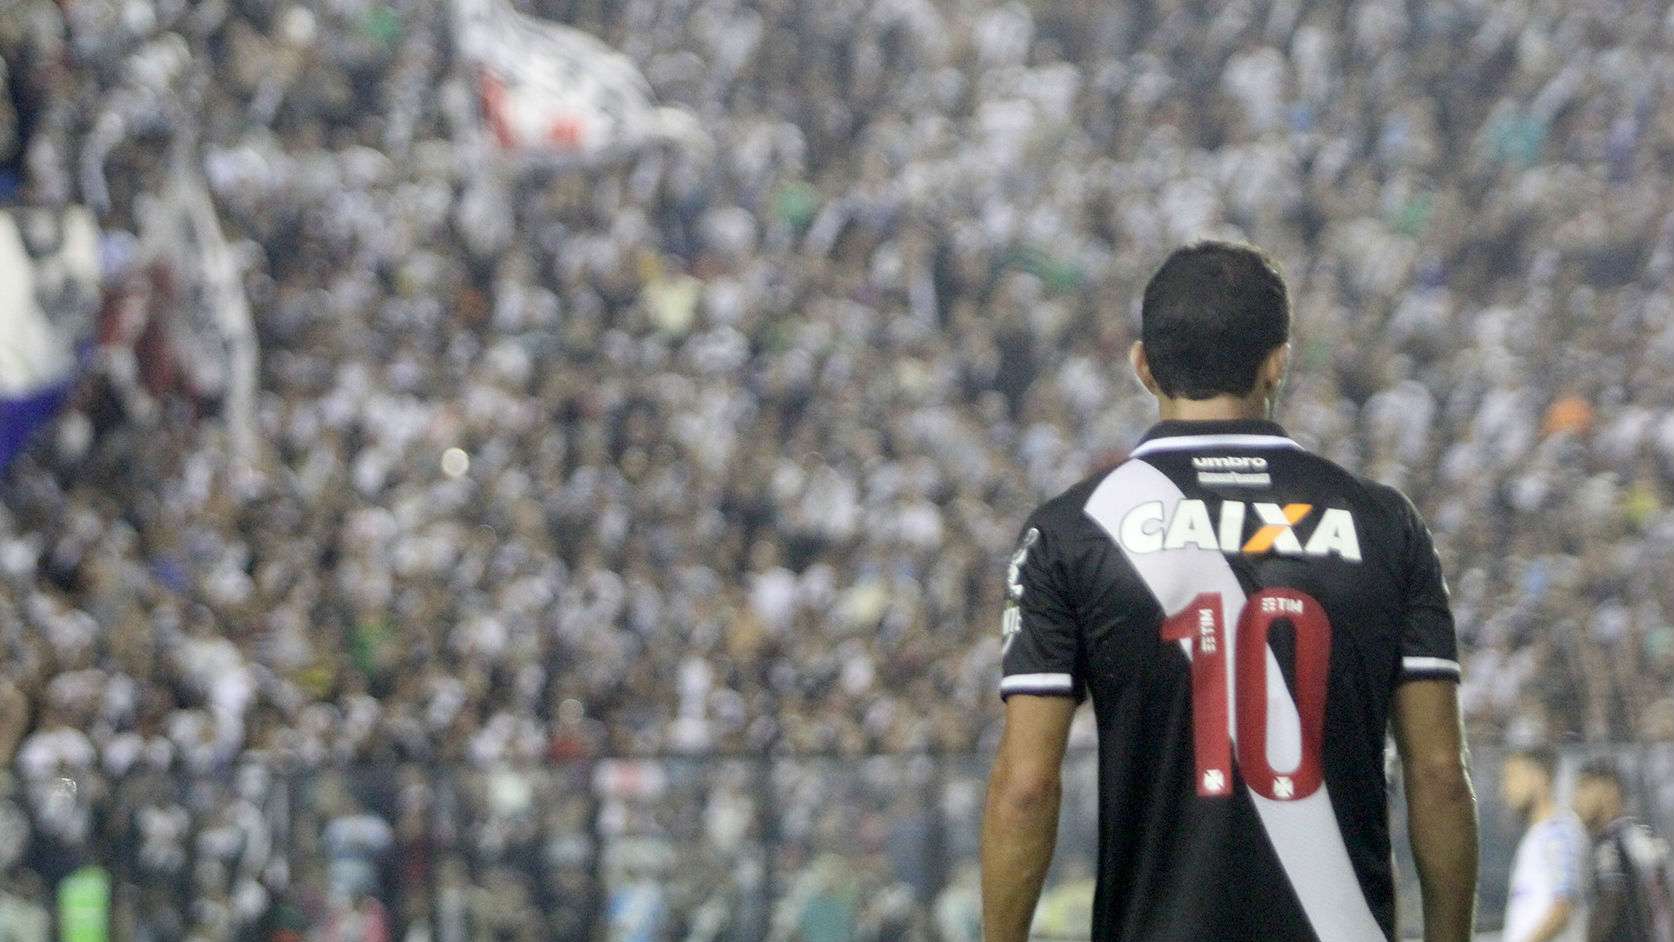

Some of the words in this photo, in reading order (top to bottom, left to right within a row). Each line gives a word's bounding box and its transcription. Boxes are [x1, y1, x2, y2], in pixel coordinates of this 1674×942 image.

[1192, 456, 1268, 470] umbro
[1120, 498, 1362, 563] CAIXA
[1277, 597, 1303, 615] TIM
[1161, 588, 1333, 801] 10
